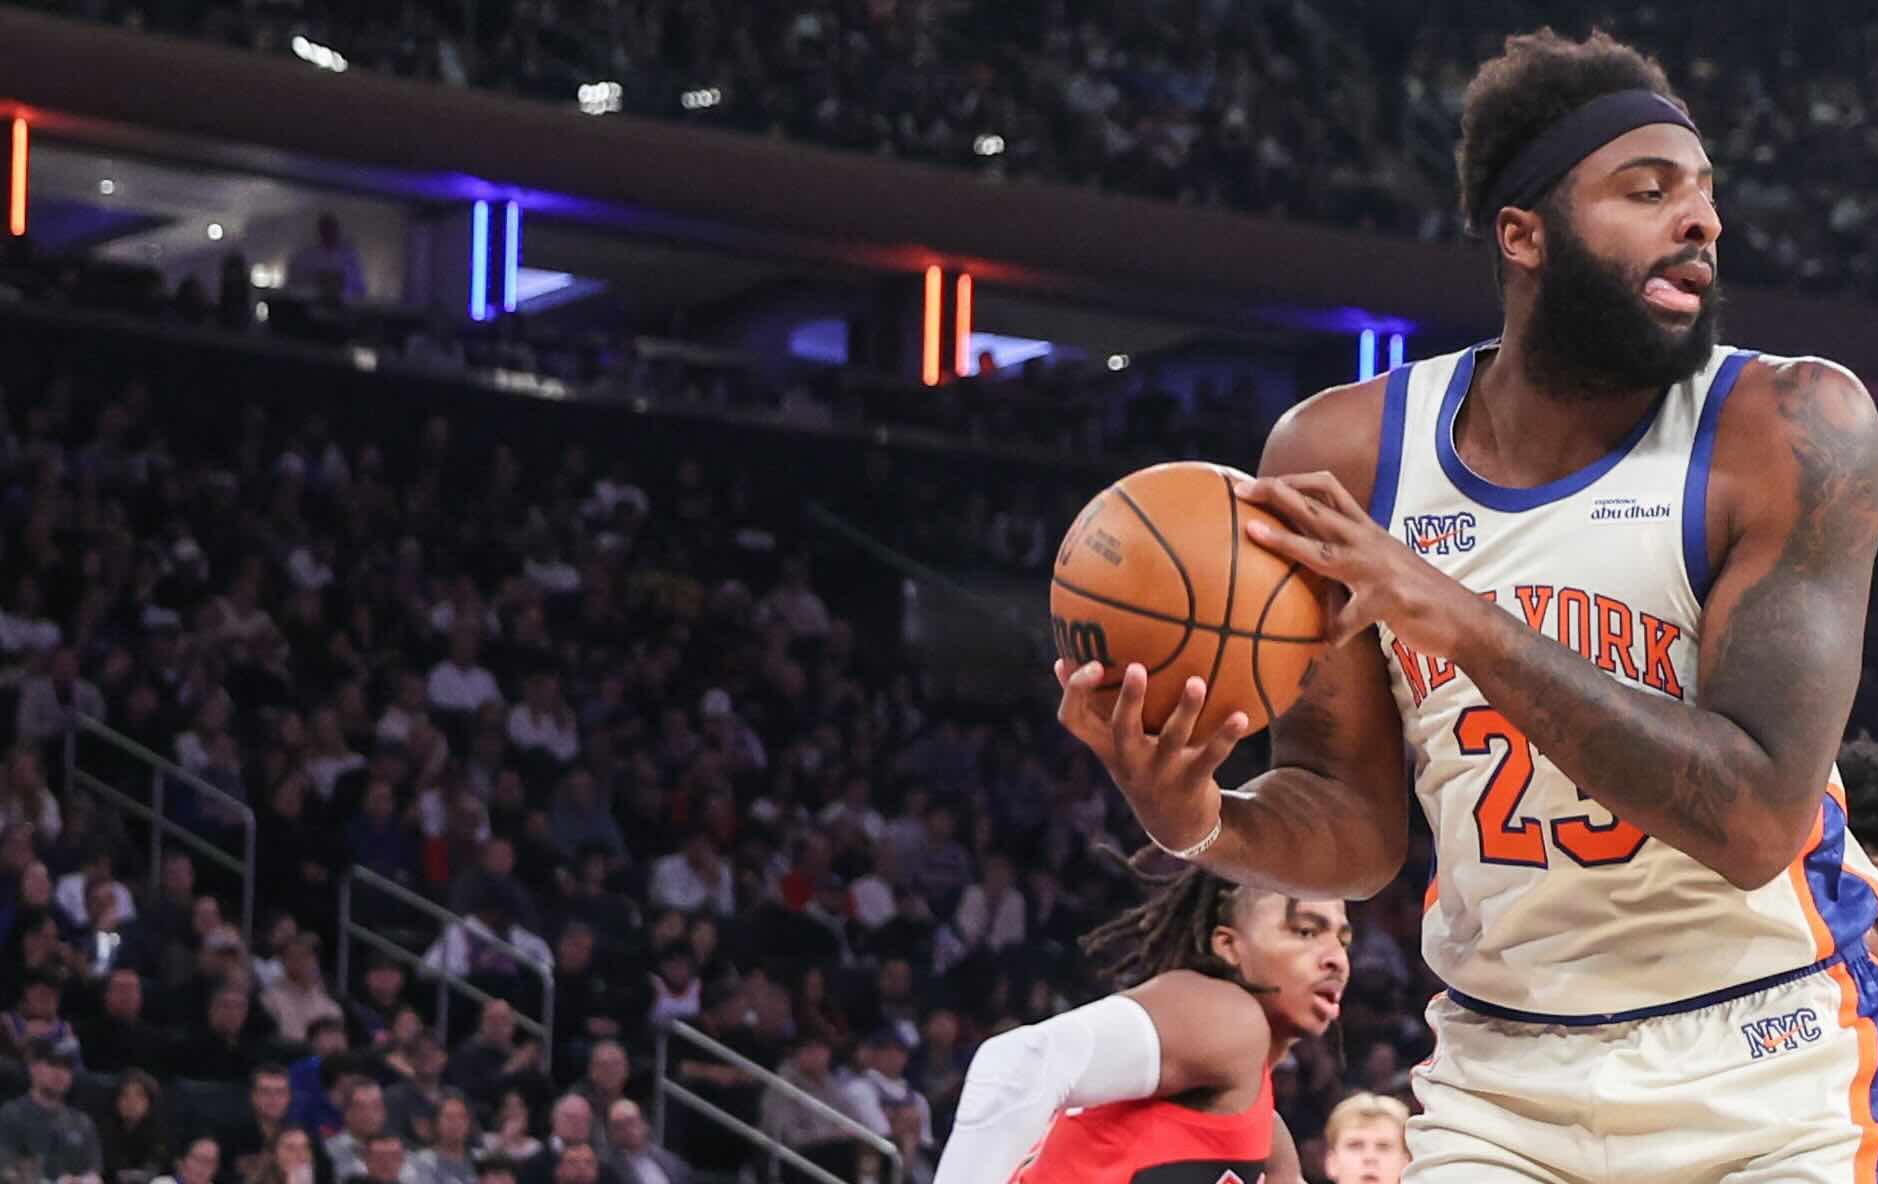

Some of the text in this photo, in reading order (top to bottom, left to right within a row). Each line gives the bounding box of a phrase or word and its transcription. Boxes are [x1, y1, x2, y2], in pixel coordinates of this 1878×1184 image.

[1404, 513, 1476, 555] NYC
[1590, 503, 1671, 520] abu dhabi
[1514, 585, 1684, 701] YORK
[1741, 1008, 1822, 1060] NYC
